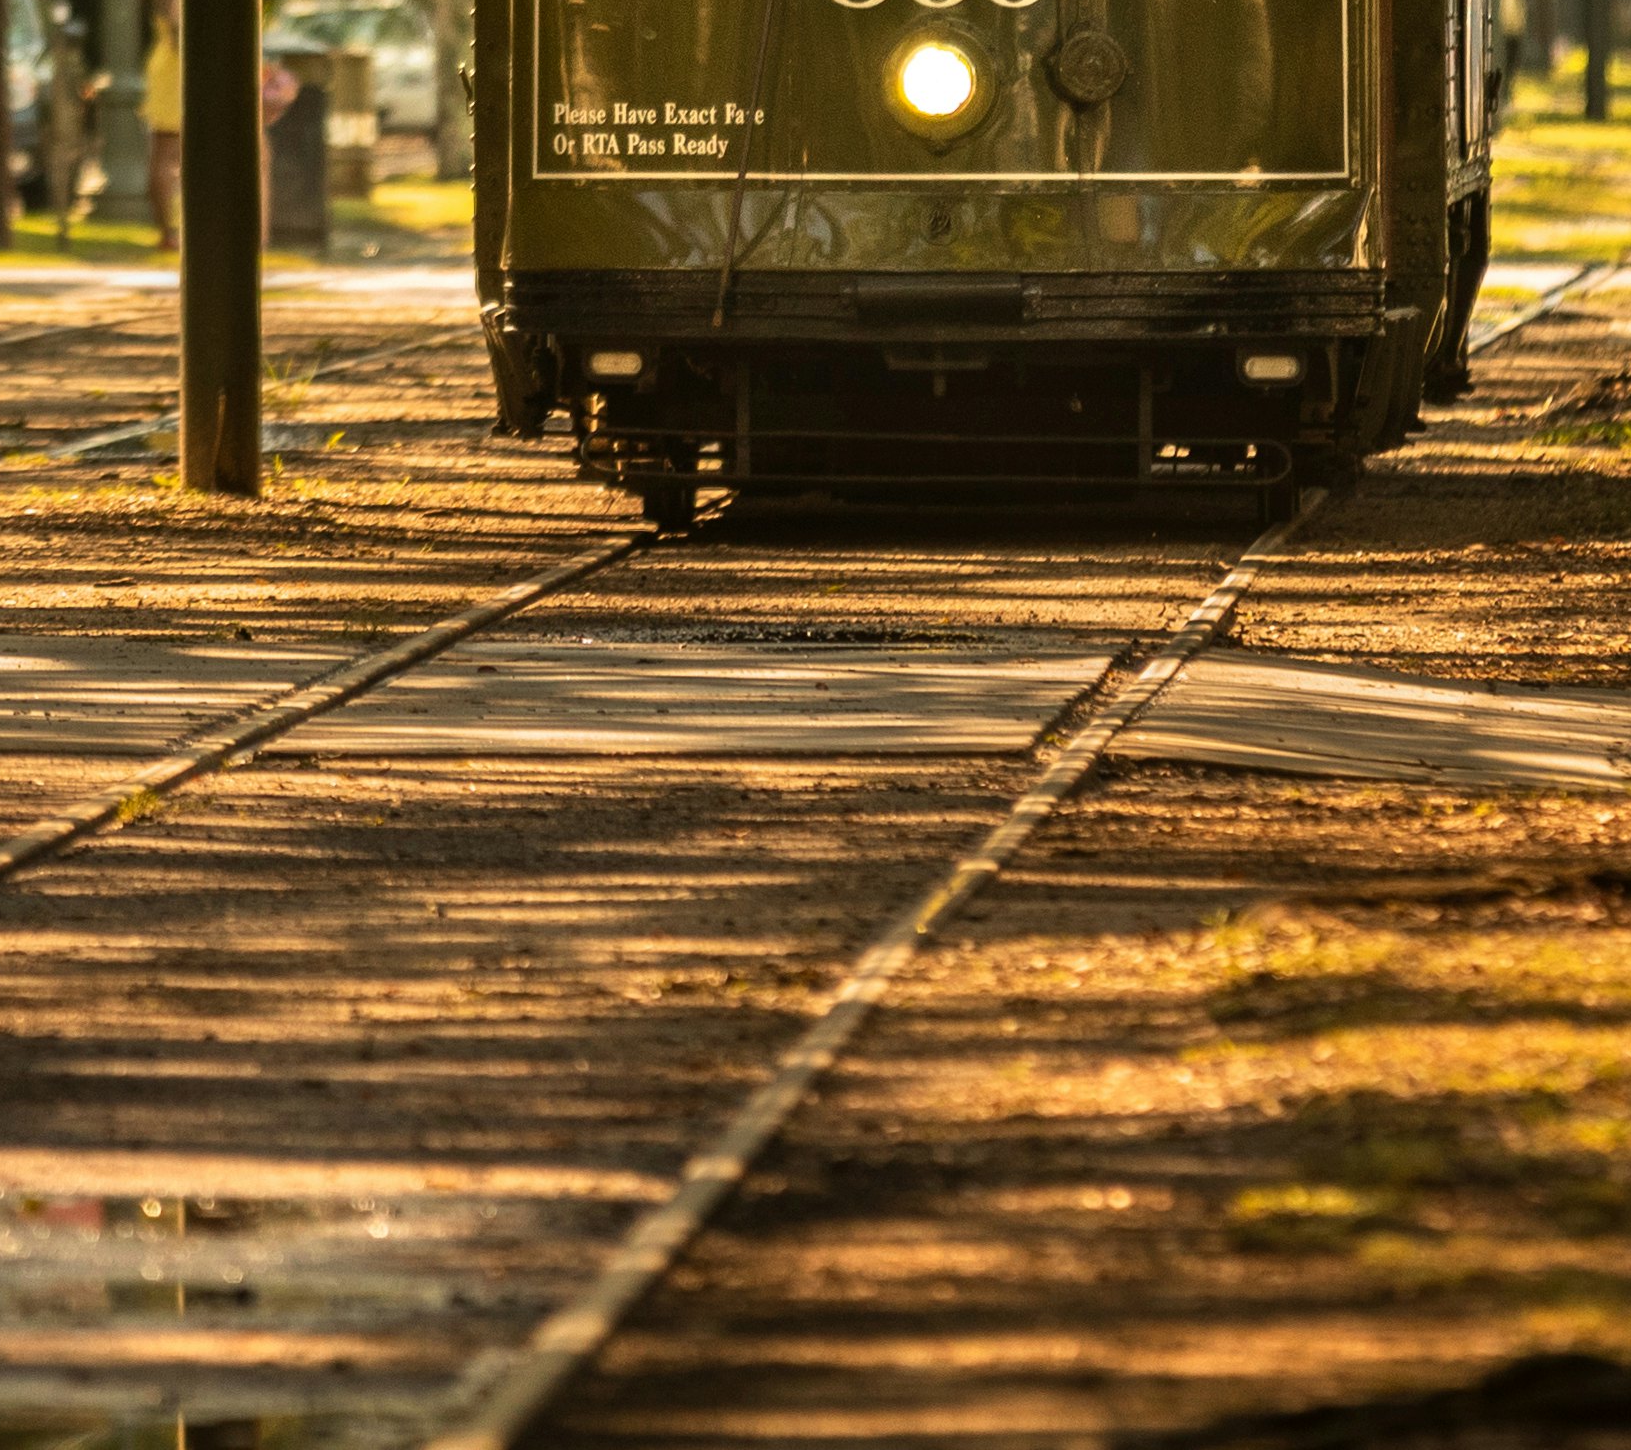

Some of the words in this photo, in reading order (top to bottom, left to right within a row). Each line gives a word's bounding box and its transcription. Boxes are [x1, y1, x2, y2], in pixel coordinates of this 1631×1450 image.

[553, 102, 607, 125] Please
[613, 102, 658, 125] Have
[664, 102, 718, 125] Exact
[724, 102, 765, 126] Fae
[552, 133, 576, 156] Or
[582, 133, 621, 156] RTA
[627, 133, 667, 155] Pass
[673, 132, 729, 160] Ready
